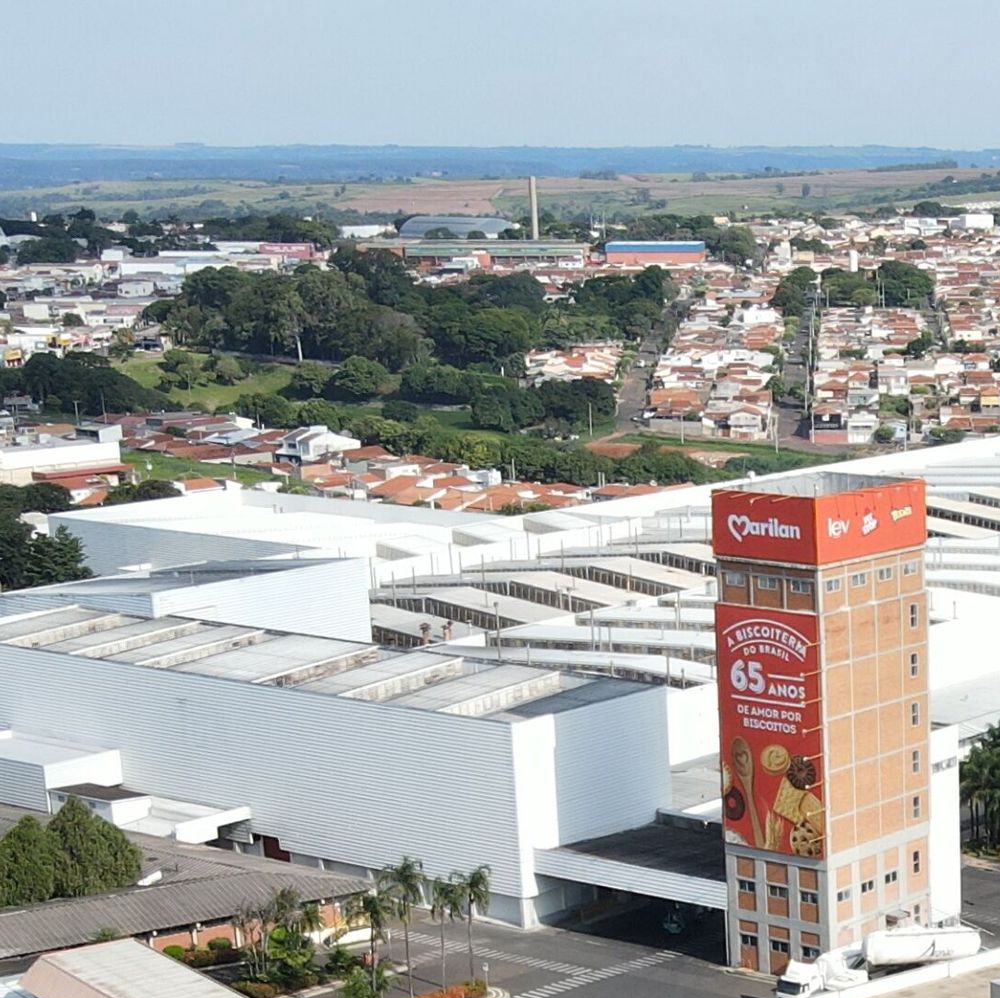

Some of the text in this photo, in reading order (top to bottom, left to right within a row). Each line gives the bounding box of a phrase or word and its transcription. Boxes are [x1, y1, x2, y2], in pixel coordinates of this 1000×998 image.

[727, 514, 800, 542] Marilan
[827, 517, 850, 538] lev
[727, 636, 735, 648] A
[743, 645, 790, 662] DO BRASIL
[730, 659, 766, 694] 65
[768, 683, 806, 699] ANOS
[737, 704, 801, 722] DE AMOR POR
[743, 718, 797, 734] BISCOITOS
